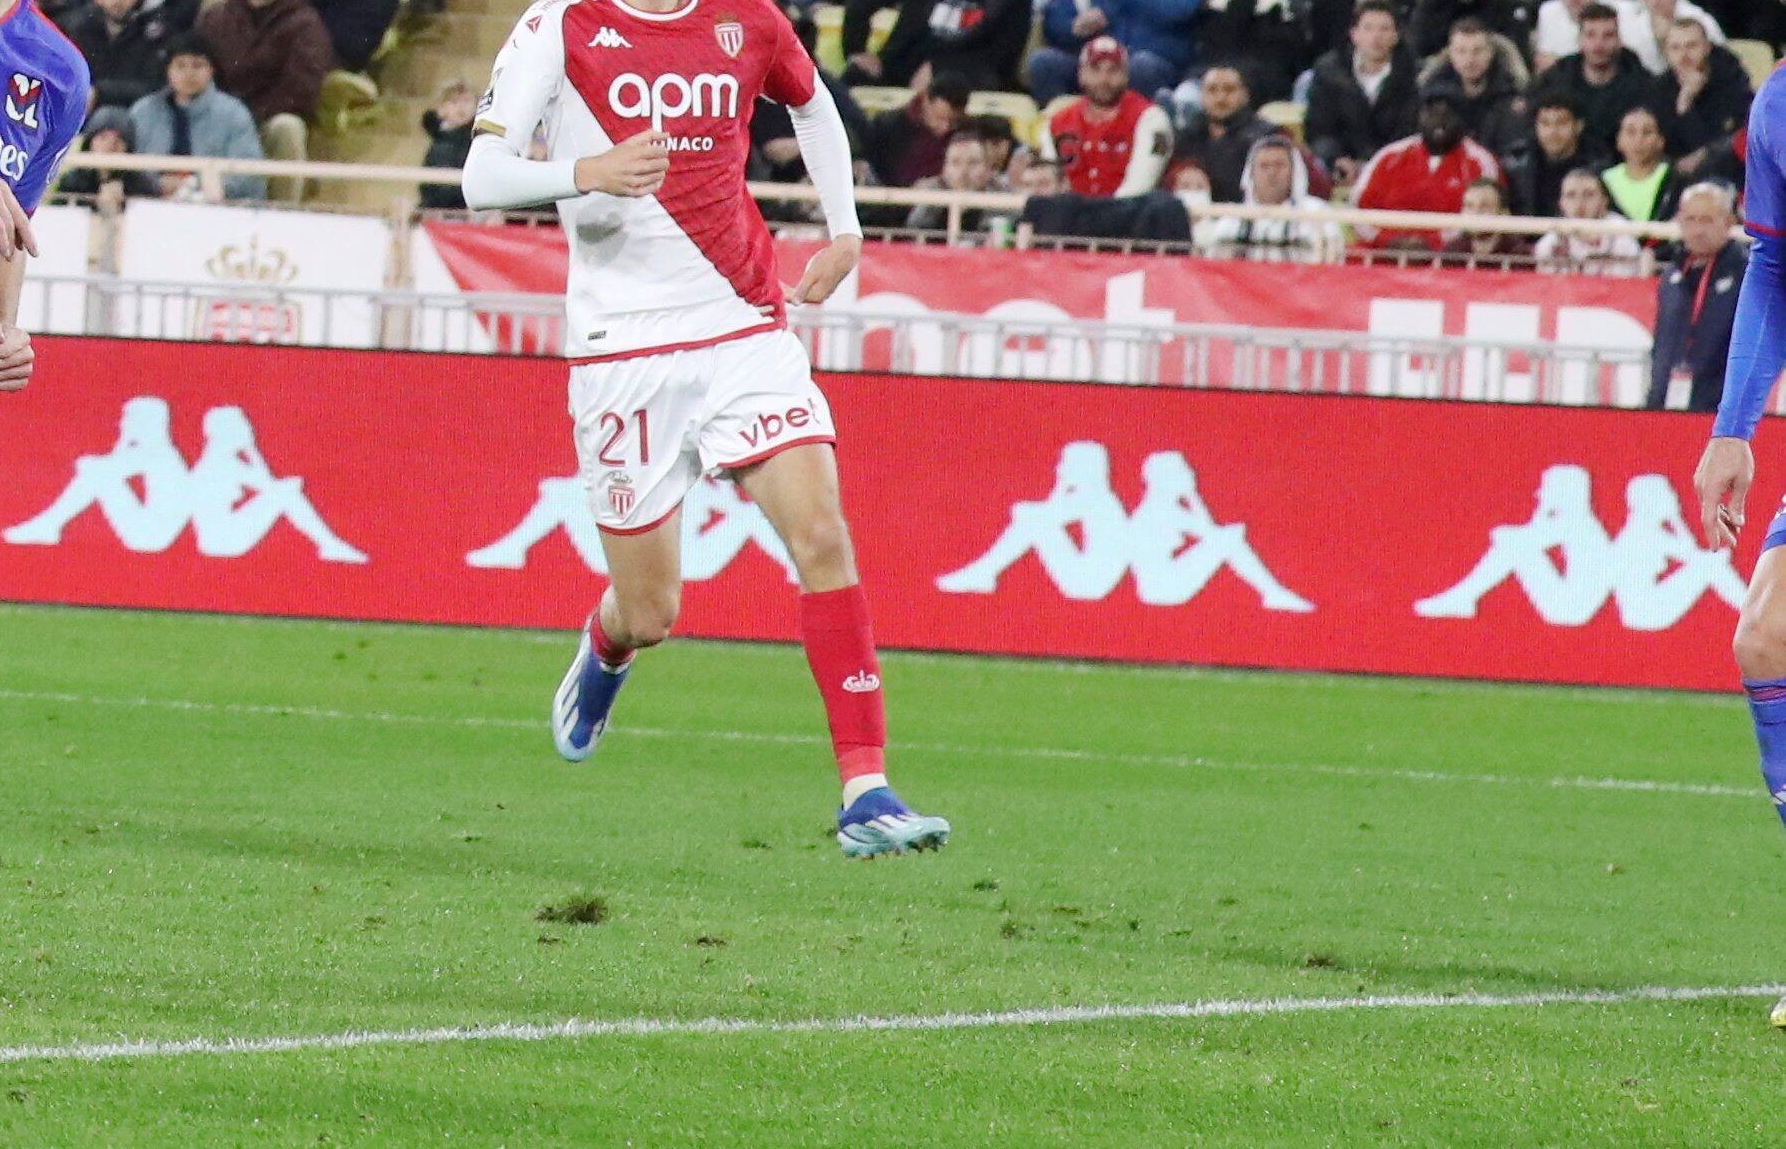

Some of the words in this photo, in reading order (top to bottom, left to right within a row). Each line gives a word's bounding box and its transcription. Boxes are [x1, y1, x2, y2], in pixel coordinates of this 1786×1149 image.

[608, 72, 740, 134] apm
[648, 136, 714, 152] NACO
[599, 408, 649, 466] 21
